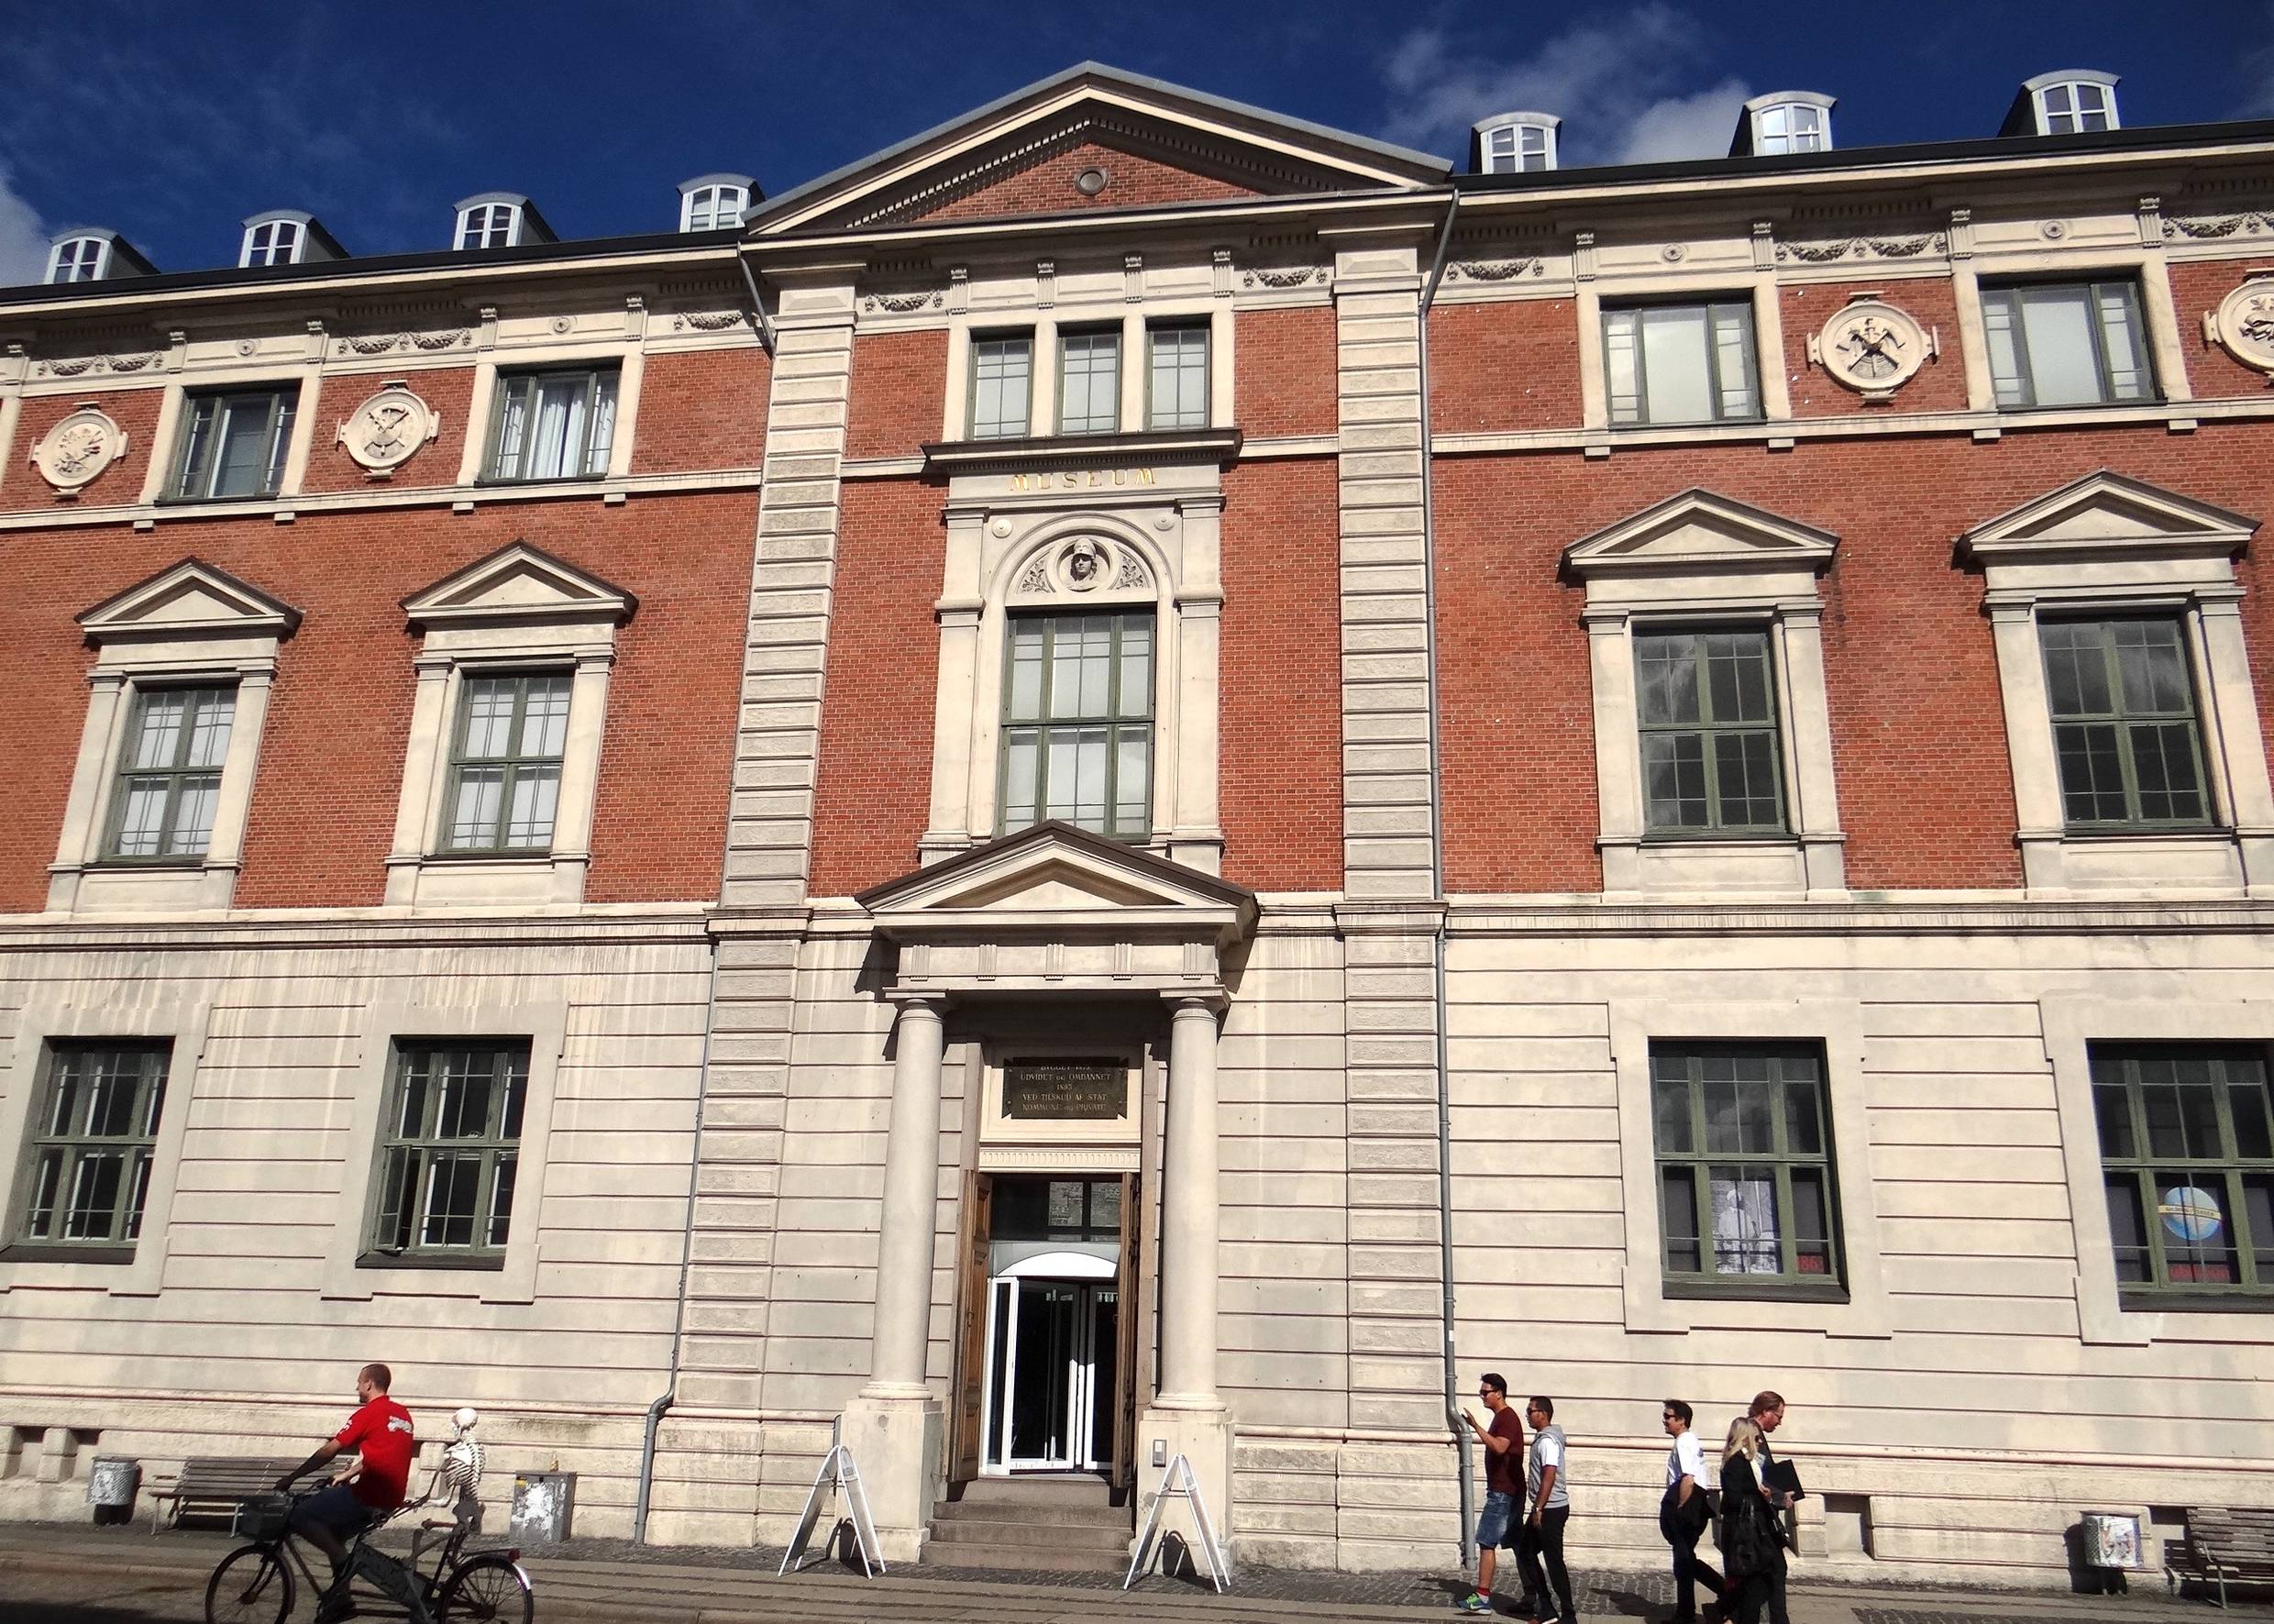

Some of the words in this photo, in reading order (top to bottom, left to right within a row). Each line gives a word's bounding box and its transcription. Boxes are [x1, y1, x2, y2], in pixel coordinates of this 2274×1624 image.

[1010, 469, 1155, 492] MUSEUM
[1021, 1073, 1054, 1081] UDVIDET
[1022, 1093, 1038, 1101] VED
[1041, 1093, 1072, 1101] TILSKUD
[1076, 1093, 1084, 1101] AF
